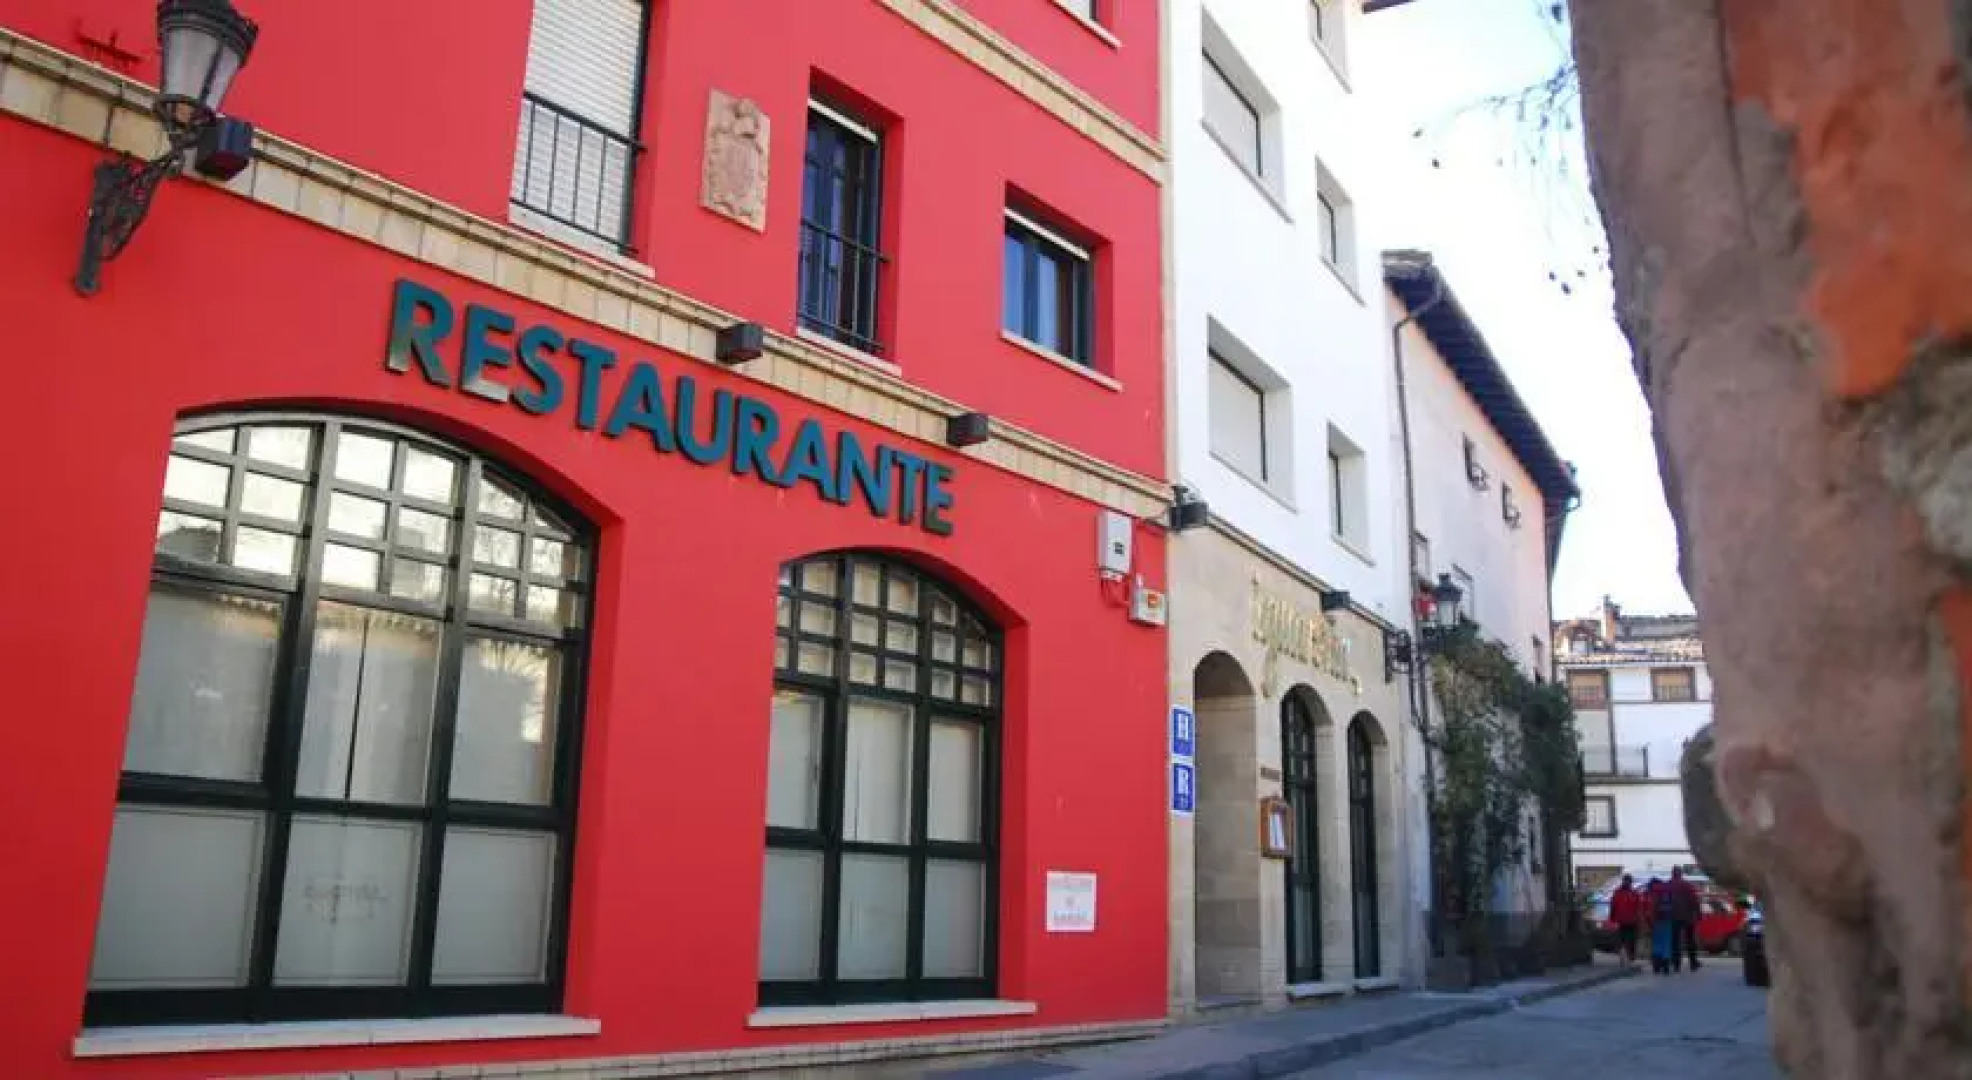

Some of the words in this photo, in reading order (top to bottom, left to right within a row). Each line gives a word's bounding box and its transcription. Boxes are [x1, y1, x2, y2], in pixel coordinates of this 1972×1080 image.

[384, 278, 954, 536] RESTAURANTE
[1177, 713, 1189, 742] H
[1176, 767, 1189, 796] R
